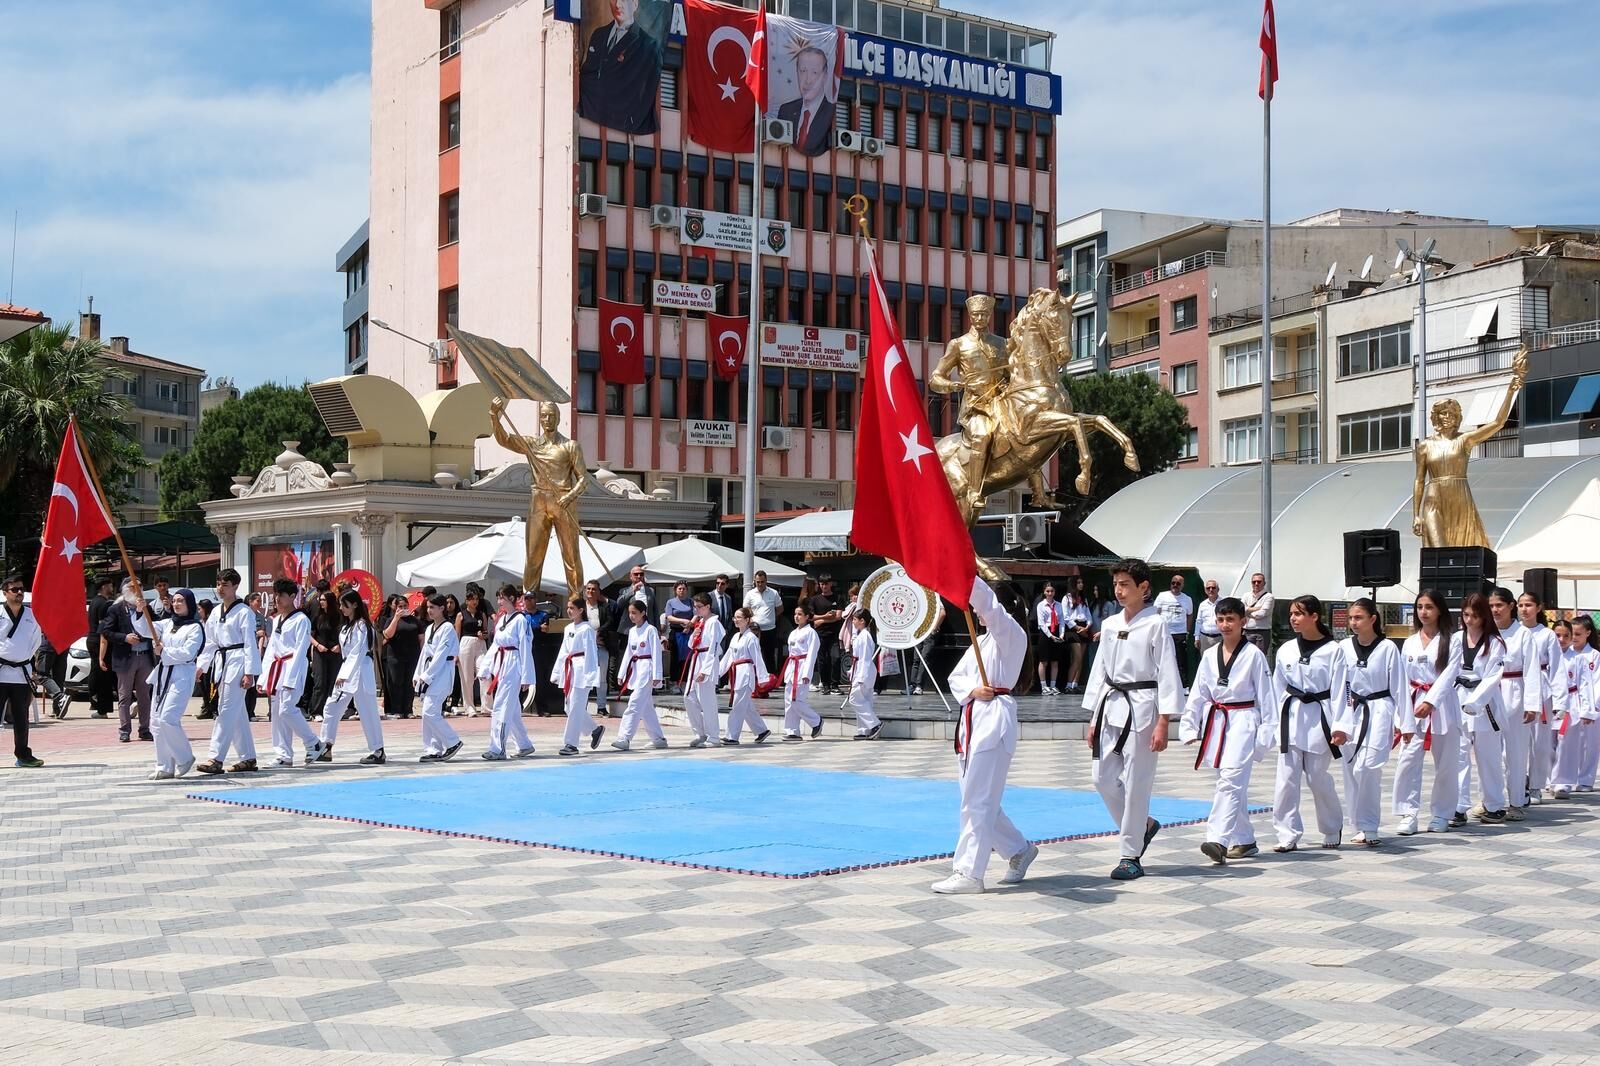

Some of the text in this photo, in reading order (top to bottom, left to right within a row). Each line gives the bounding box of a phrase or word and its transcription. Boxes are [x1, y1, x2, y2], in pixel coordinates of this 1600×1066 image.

[844, 32, 886, 76] İLÇE
[893, 47, 1017, 100] BAŞKANLIĞI
[656, 297, 689, 305] MUHTARLAR
[694, 422, 730, 431] AVUKAT
